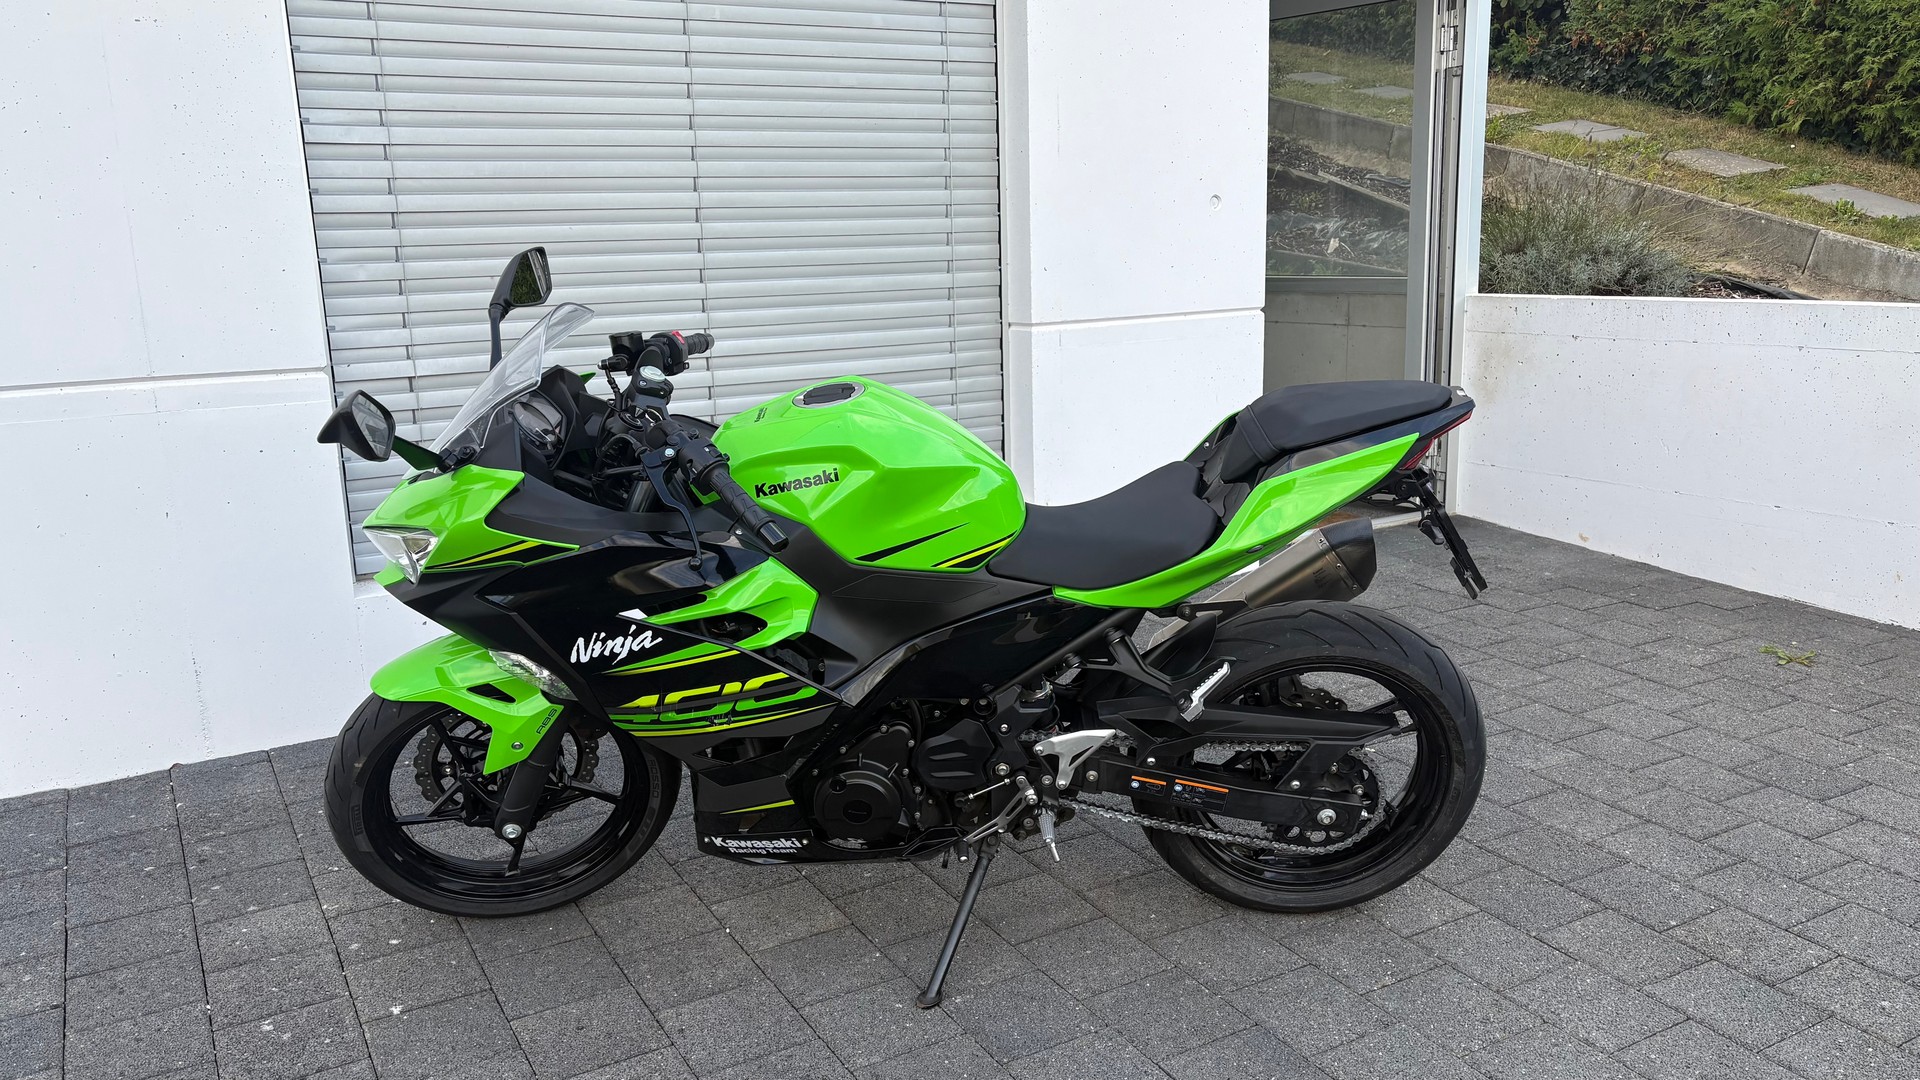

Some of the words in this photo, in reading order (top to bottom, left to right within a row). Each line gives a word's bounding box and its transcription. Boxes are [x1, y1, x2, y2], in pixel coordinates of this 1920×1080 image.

[754, 467, 840, 498] Kawasaki
[570, 624, 663, 665] Ninja
[535, 708, 558, 735] ABS
[711, 836, 803, 848] Kawasaki
[728, 847, 767, 855] Racing
